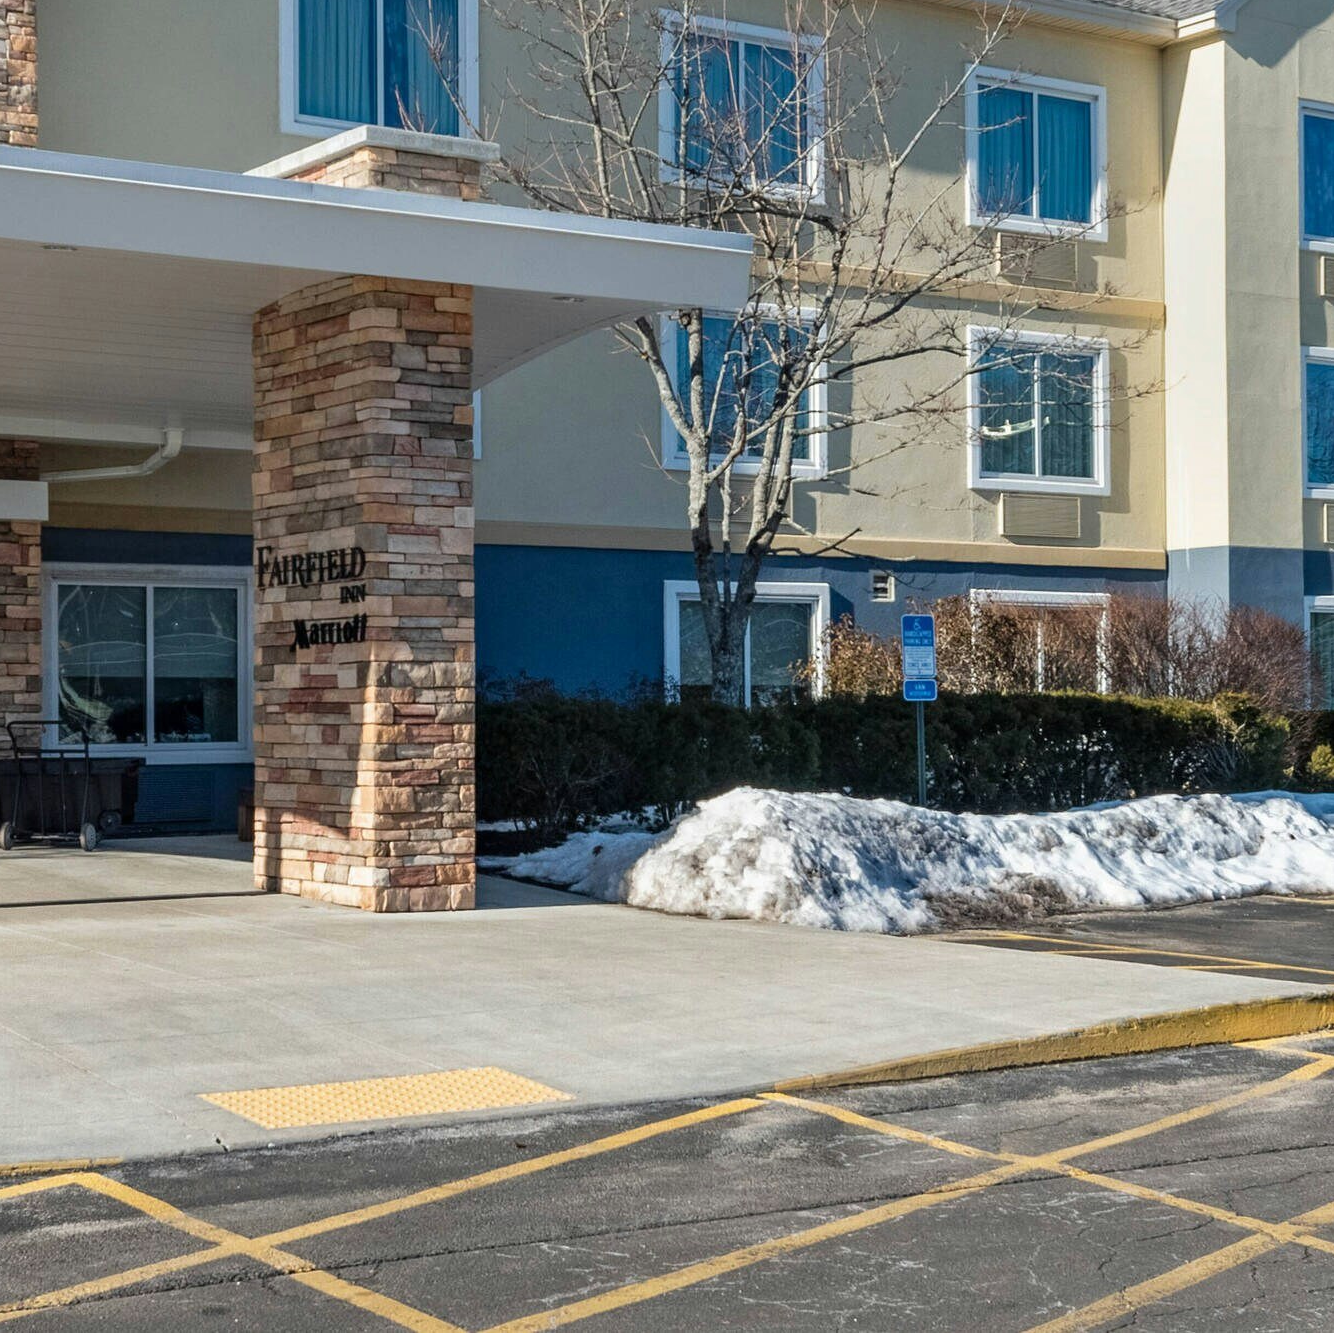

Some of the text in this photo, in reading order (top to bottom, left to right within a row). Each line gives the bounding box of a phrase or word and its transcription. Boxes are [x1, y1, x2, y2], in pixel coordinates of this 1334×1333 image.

[256, 545, 366, 589] FAIRFIELD
[339, 584, 367, 604] INN
[289, 612, 368, 653] Marriott
